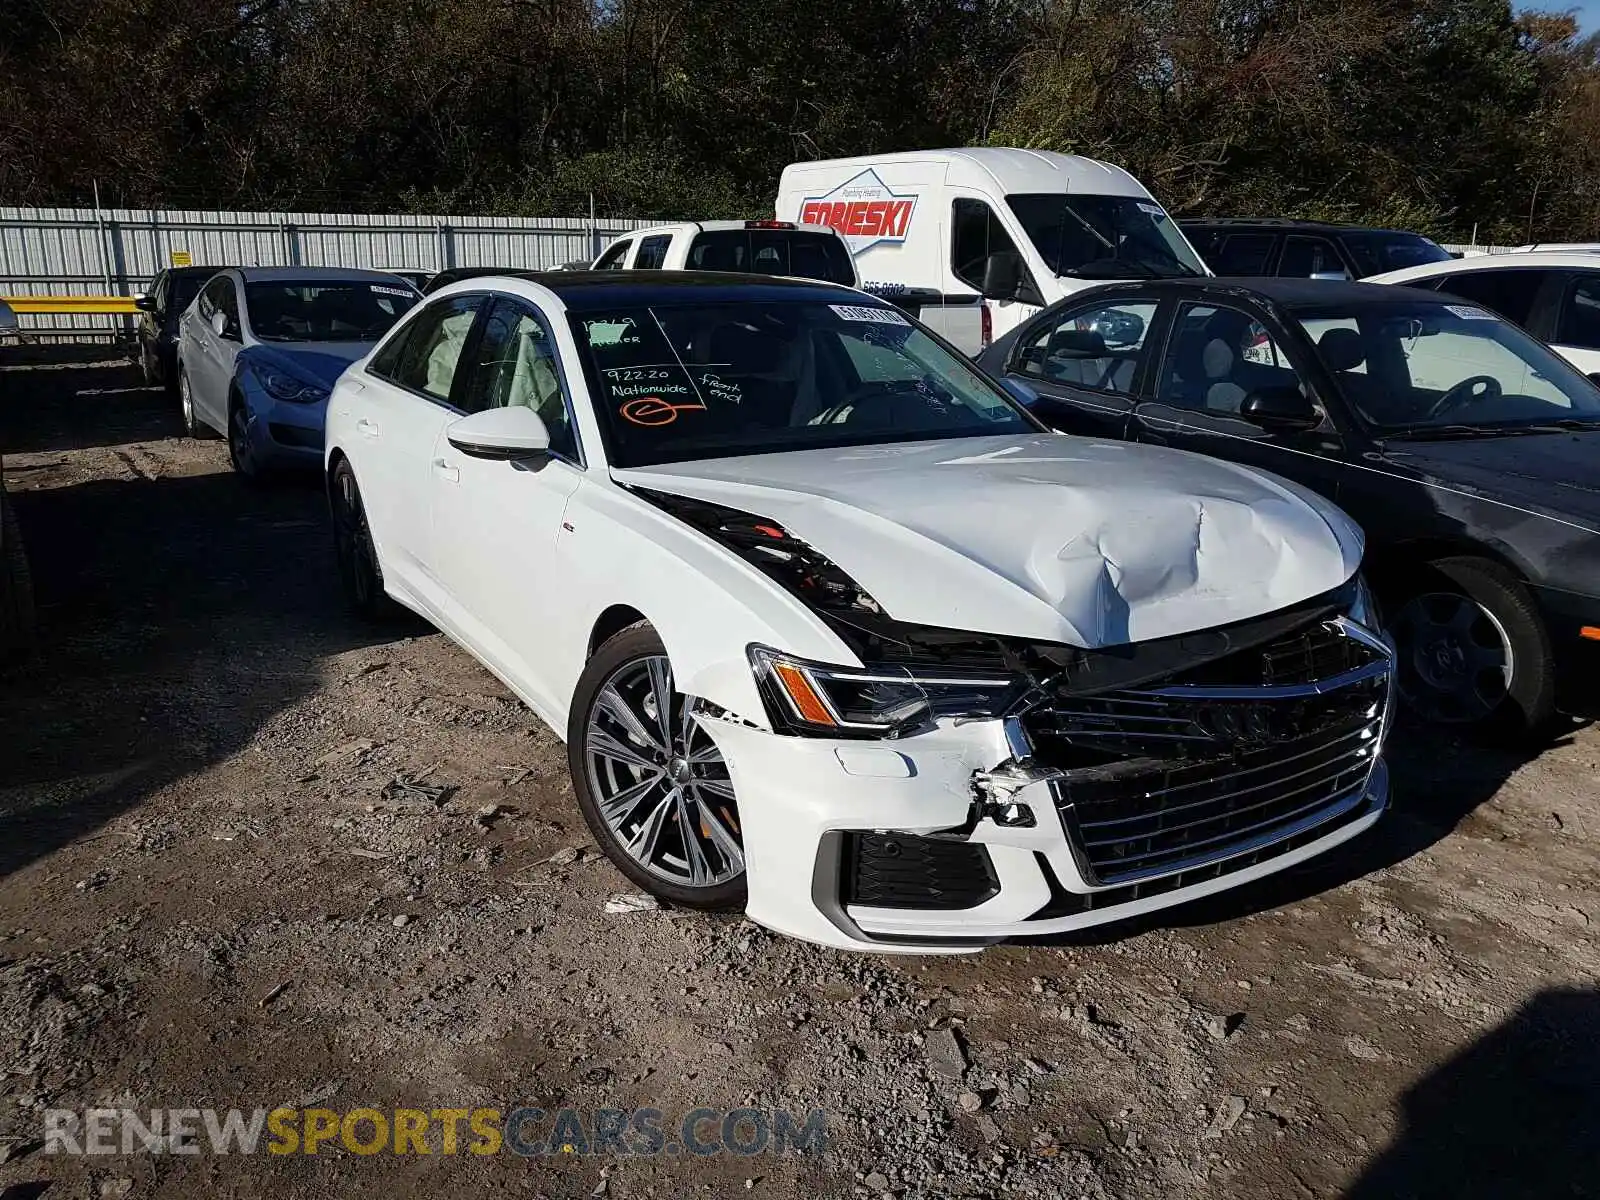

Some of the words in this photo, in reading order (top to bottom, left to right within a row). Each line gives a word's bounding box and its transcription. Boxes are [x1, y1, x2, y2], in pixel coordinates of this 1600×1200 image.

[803, 201, 913, 236] SOBIESKI
[611, 384, 689, 397] Nationwide
[710, 389, 743, 405] end
